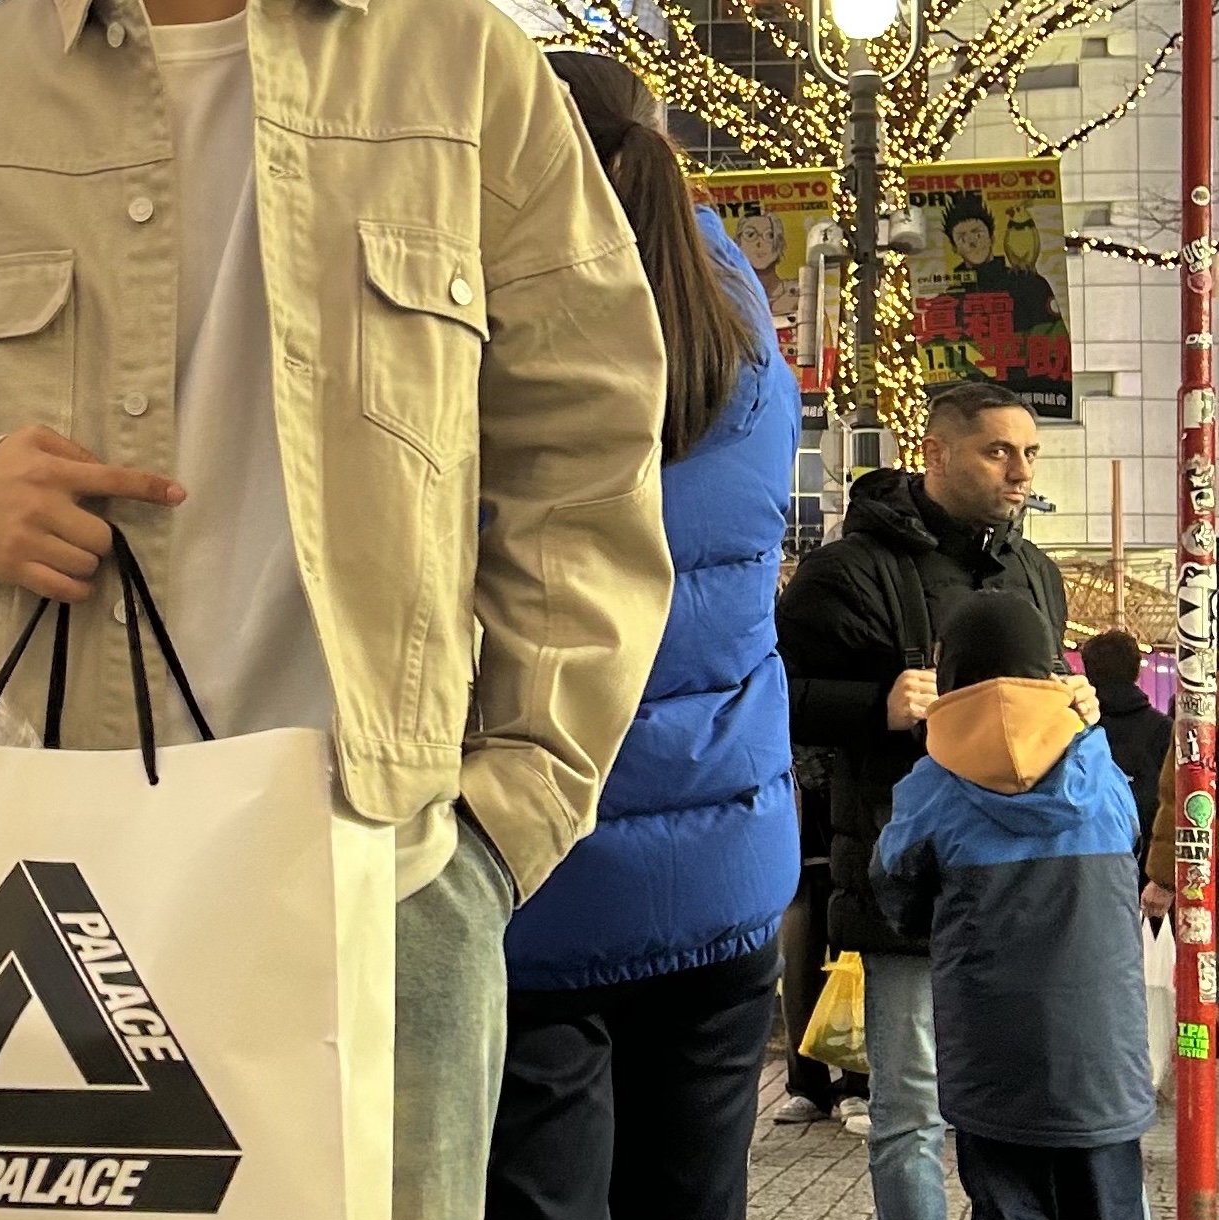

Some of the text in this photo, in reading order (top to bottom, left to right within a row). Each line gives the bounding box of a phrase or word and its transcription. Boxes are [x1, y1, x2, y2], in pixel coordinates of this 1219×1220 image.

[907, 169, 1056, 191] SAKAMOTO
[692, 181, 829, 203] AKAMOTO
[56, 912, 185, 1062] PALACE
